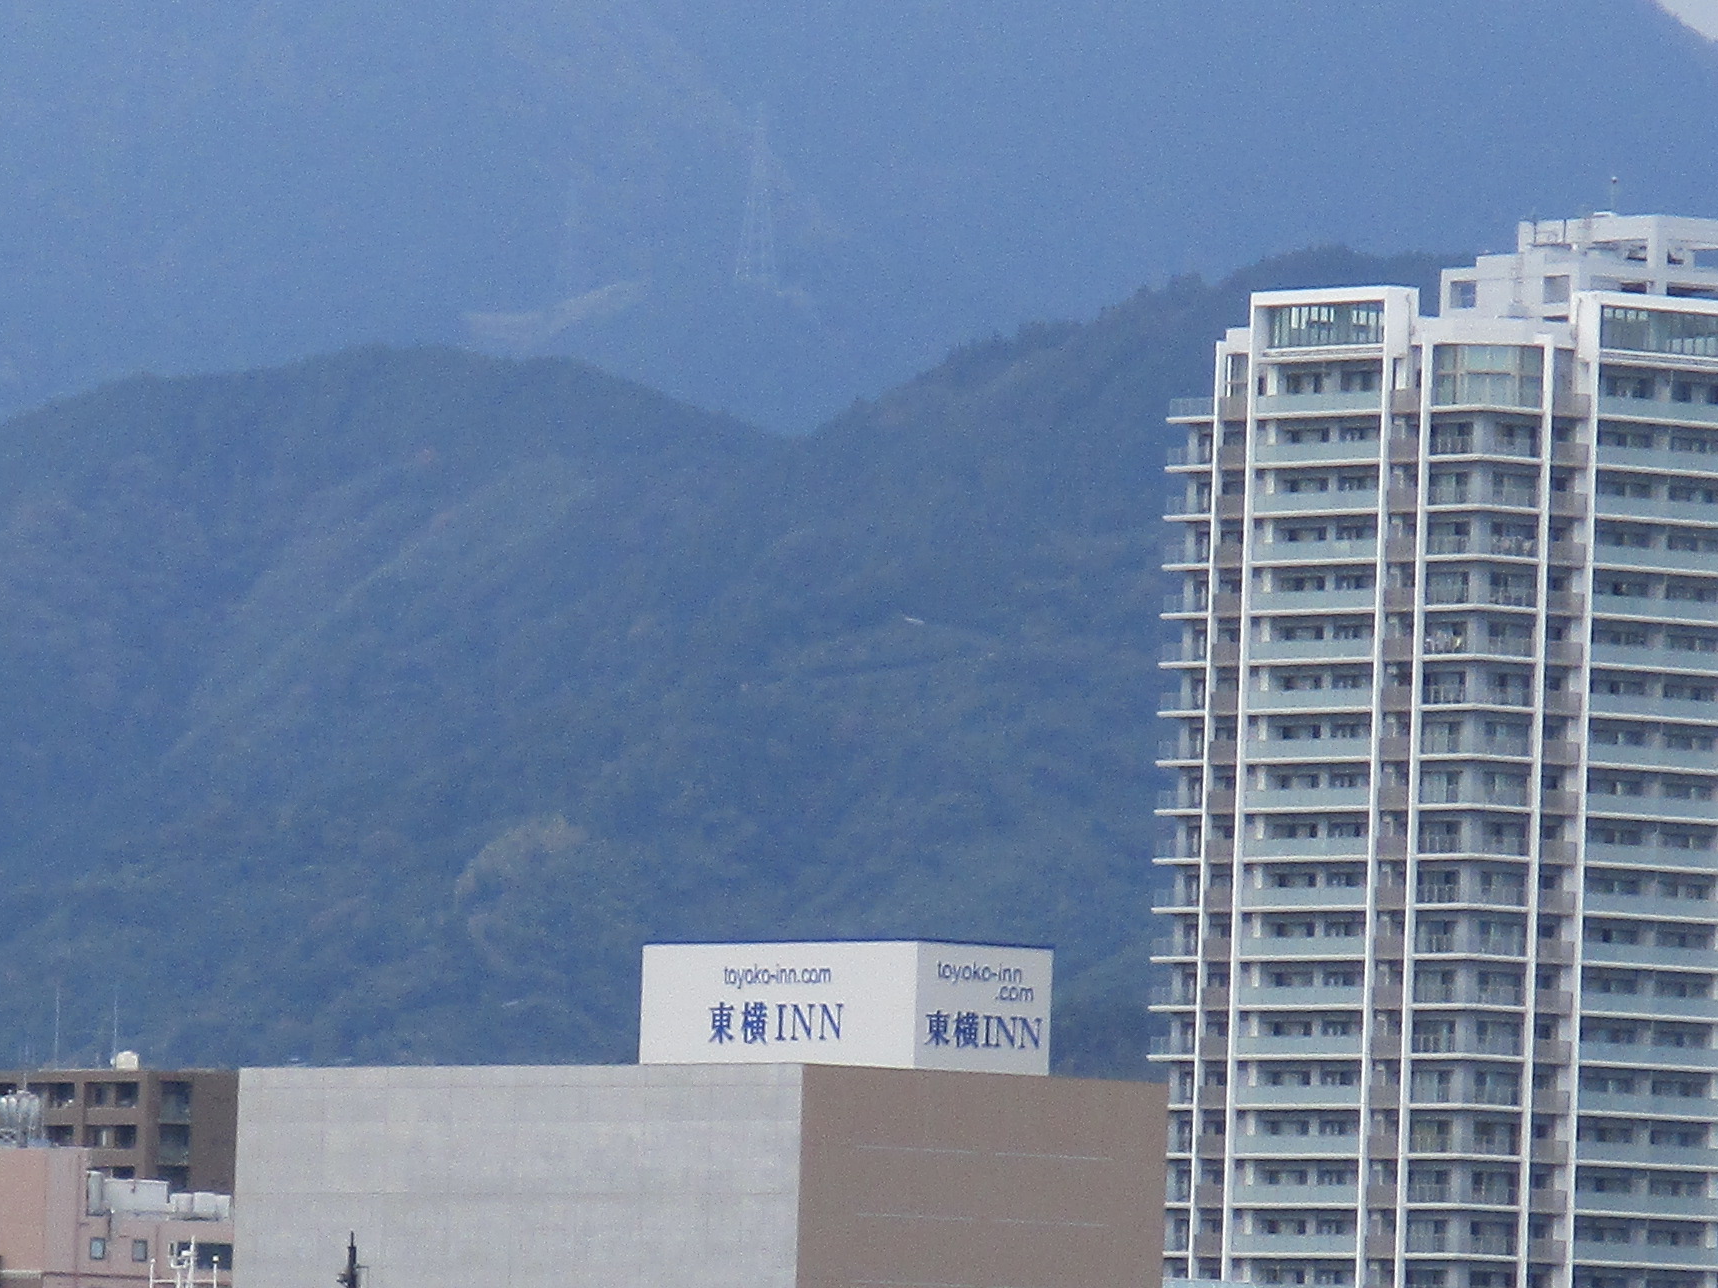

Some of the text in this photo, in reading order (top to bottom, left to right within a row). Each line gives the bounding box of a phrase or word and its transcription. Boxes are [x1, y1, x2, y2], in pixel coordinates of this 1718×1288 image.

[723, 963, 832, 990] toyoko-inn.com
[937, 961, 1023, 985] toyoko-inn
[995, 984, 1035, 1003] .com
[707, 1000, 845, 1046] 東横INN
[925, 1009, 1043, 1050] 東横INN
